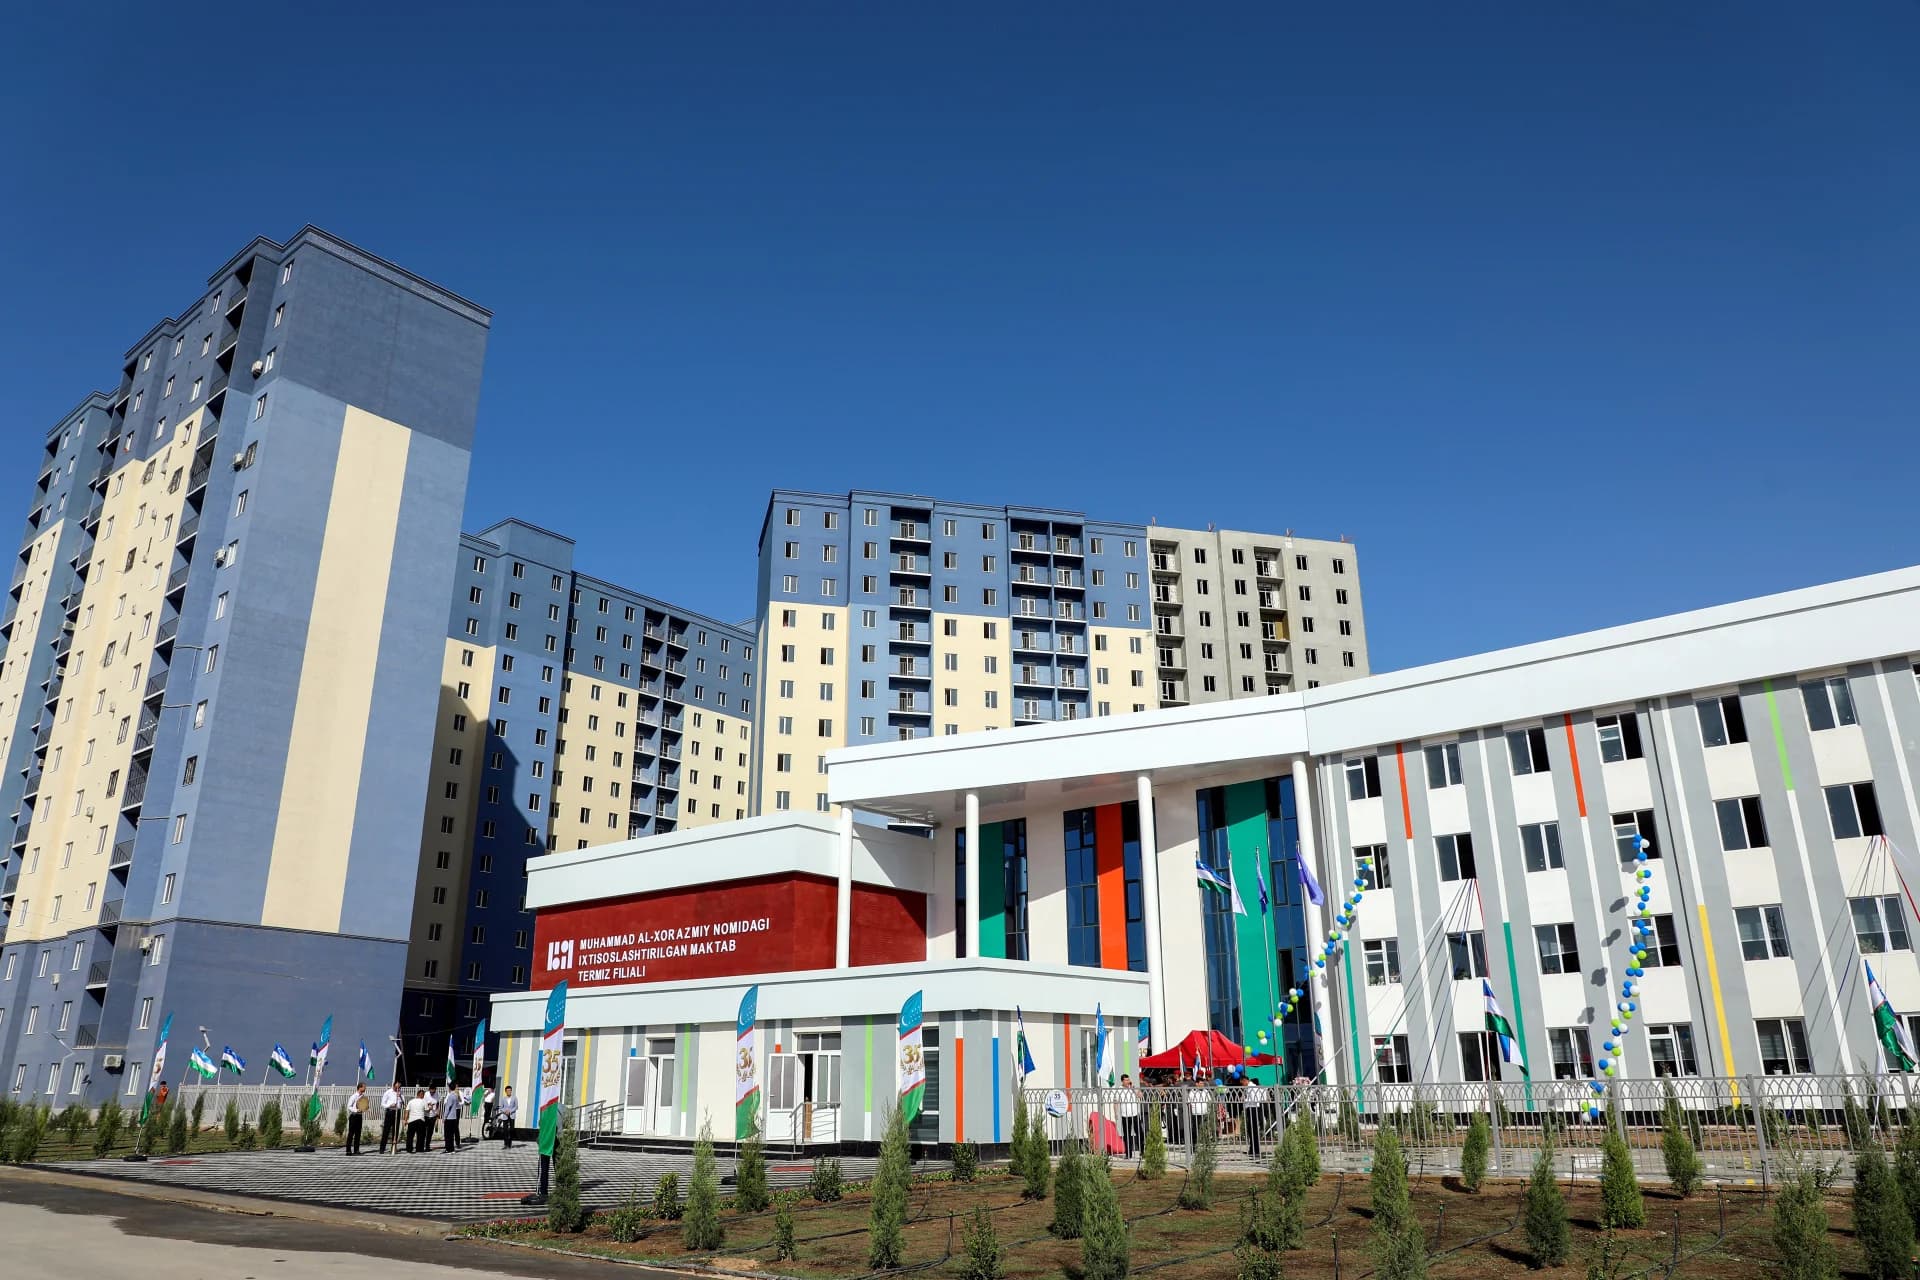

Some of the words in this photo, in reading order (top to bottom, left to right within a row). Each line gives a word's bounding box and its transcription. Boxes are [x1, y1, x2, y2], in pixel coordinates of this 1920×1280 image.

[580, 934, 635, 950] MUHAMMAD
[638, 925, 710, 944] AL-XORAZMIY
[713, 918, 770, 936] NOMIDAGI
[578, 945, 687, 966] IXTISOSLASHTIRILGAN
[690, 939, 736, 956] MAKTAB
[578, 968, 610, 982] TERMIZ
[613, 965, 645, 980] FILIALI
[543, 1049, 560, 1073] 35
